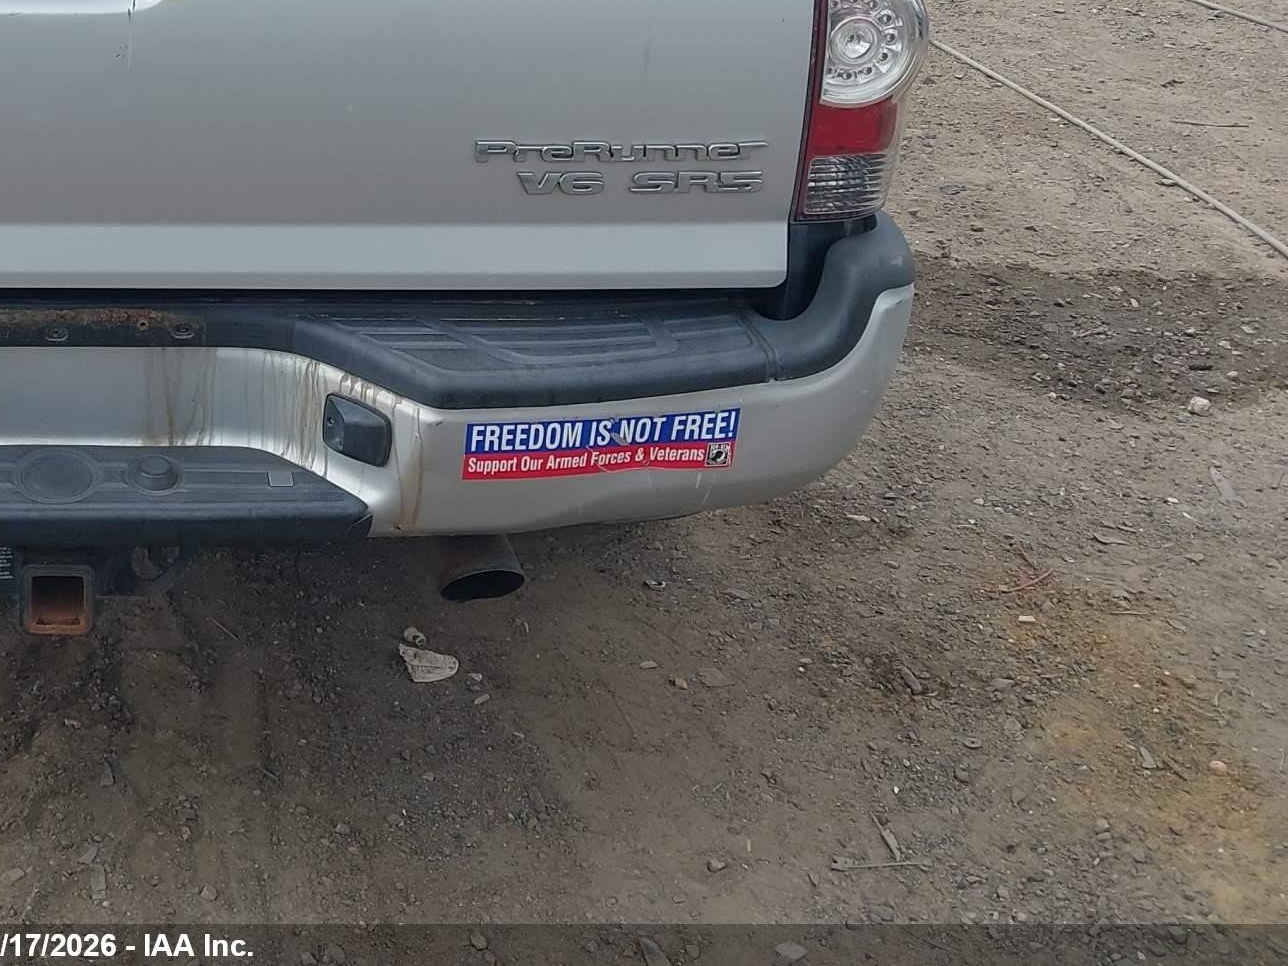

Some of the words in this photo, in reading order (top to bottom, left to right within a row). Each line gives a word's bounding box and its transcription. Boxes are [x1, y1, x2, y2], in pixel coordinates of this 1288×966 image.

[475, 140, 769, 163] PreRunner
[517, 171, 605, 195] V6
[629, 171, 763, 194] SR5
[470, 422, 583, 452] FREEDOM
[589, 420, 612, 447] IS
[619, 417, 667, 444] NOT
[671, 411, 735, 440] FREE!
[468, 457, 517, 474] Support
[521, 455, 543, 471] Our
[546, 453, 587, 469] Armed
[590, 450, 631, 466] Forces
[634, 448, 645, 462] &
[650, 446, 705, 462] Veterans
